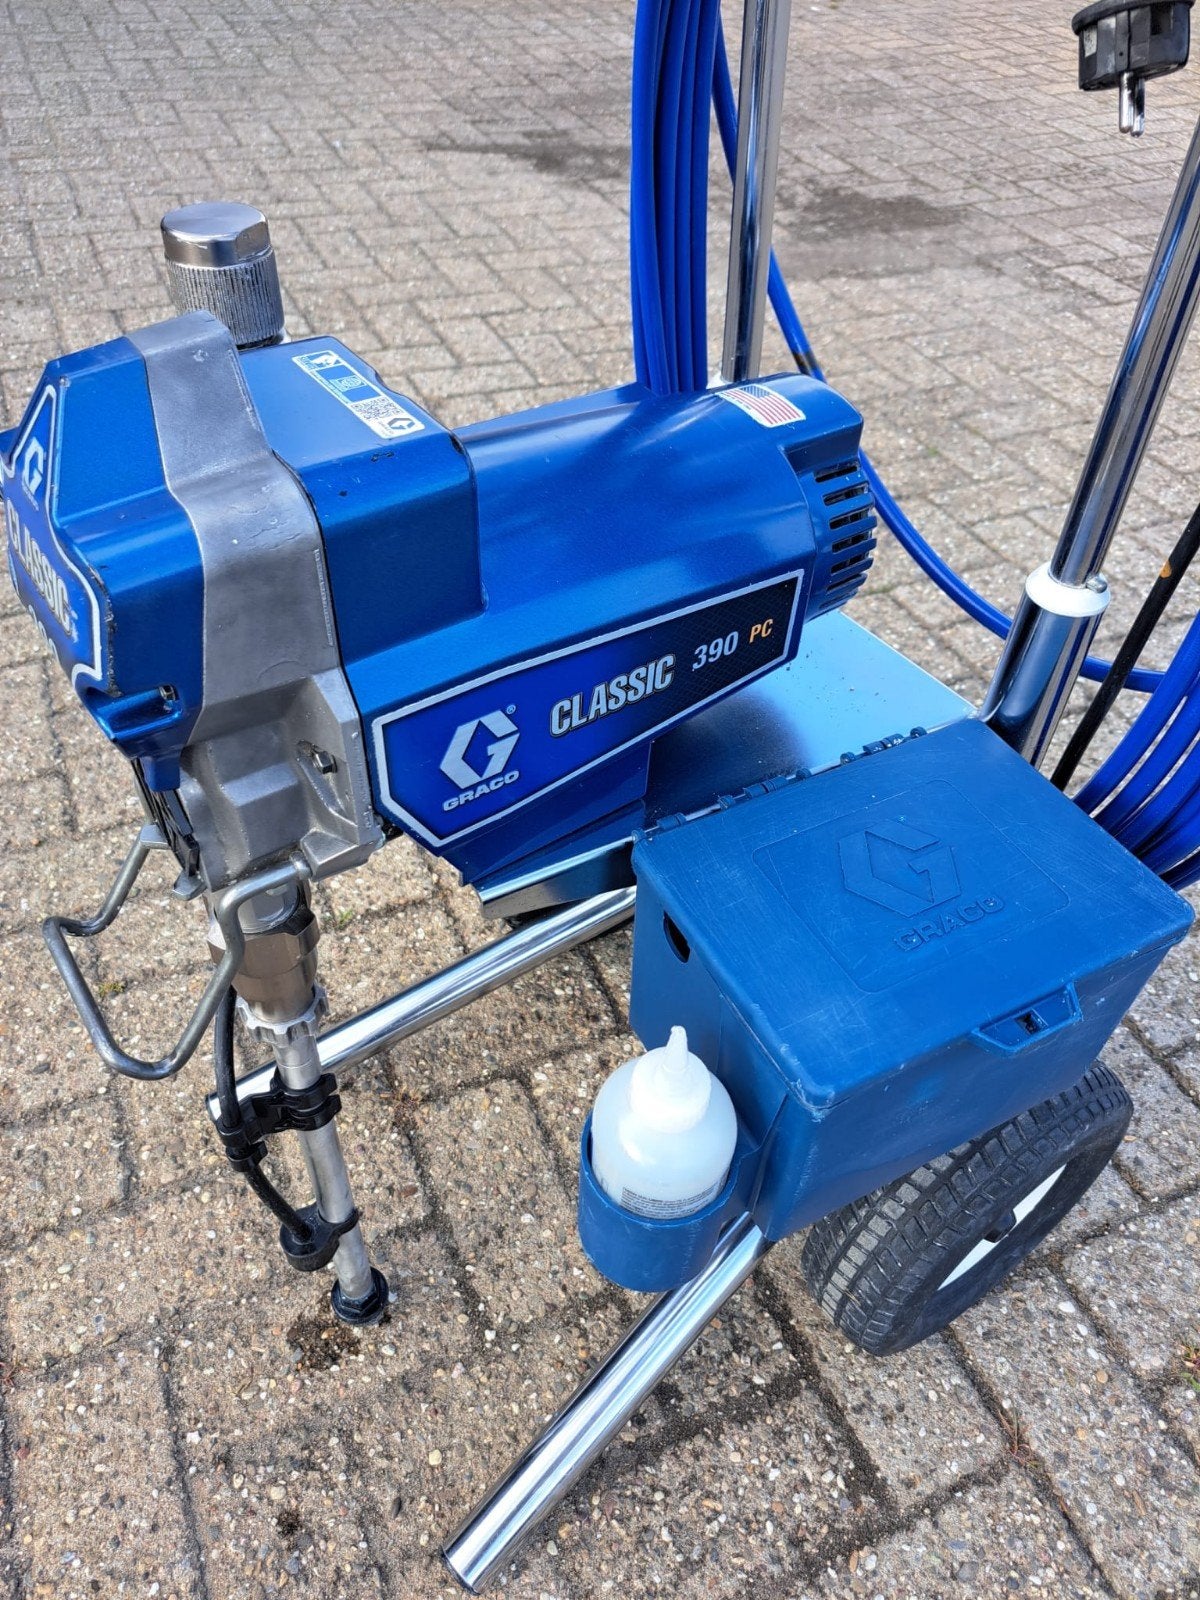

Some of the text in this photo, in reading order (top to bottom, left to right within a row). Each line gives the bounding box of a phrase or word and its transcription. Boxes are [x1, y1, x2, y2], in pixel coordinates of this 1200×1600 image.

[7, 497, 71, 636] CLASSIC
[550, 618, 774, 738] CLASSIC 390 PC
[443, 770, 519, 811] GRACO
[895, 896, 1005, 951] GRACO
